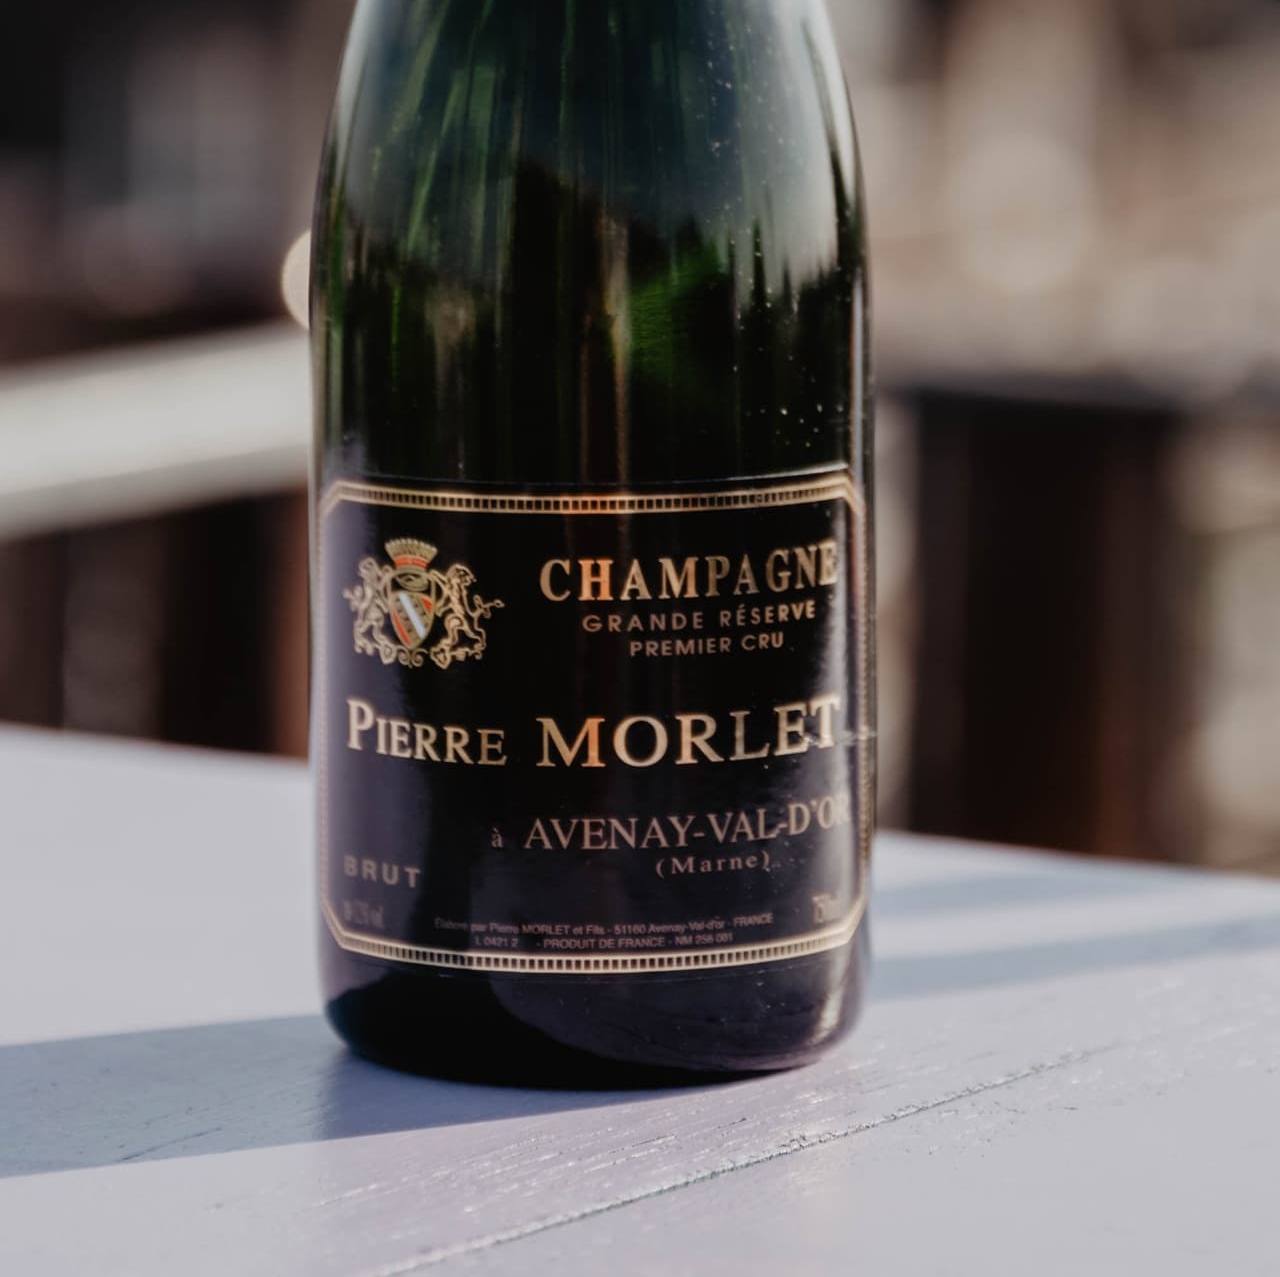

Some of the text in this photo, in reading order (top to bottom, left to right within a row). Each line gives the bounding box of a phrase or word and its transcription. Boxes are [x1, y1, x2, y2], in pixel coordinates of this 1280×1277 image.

[540, 540, 837, 602] CHAMPAGNE
[582, 600, 817, 633] GRANDE RÉSERVE
[630, 631, 784, 658] PREMIER CRU
[346, 694, 841, 768] PIERRE MORLET
[491, 793, 850, 851] à AVENAY-VAL-D'OR
[343, 854, 422, 889] BRUT
[655, 851, 770, 878] (Marne)
[521, 923, 570, 935] MORLET
[573, 925, 584, 935] et
[586, 924, 605, 935] Fils
[733, 912, 775, 928] FRANCE
[543, 938, 596, 949] PRODUIT
[599, 938, 615, 948] DE
[618, 936, 665, 948] FRANCE
